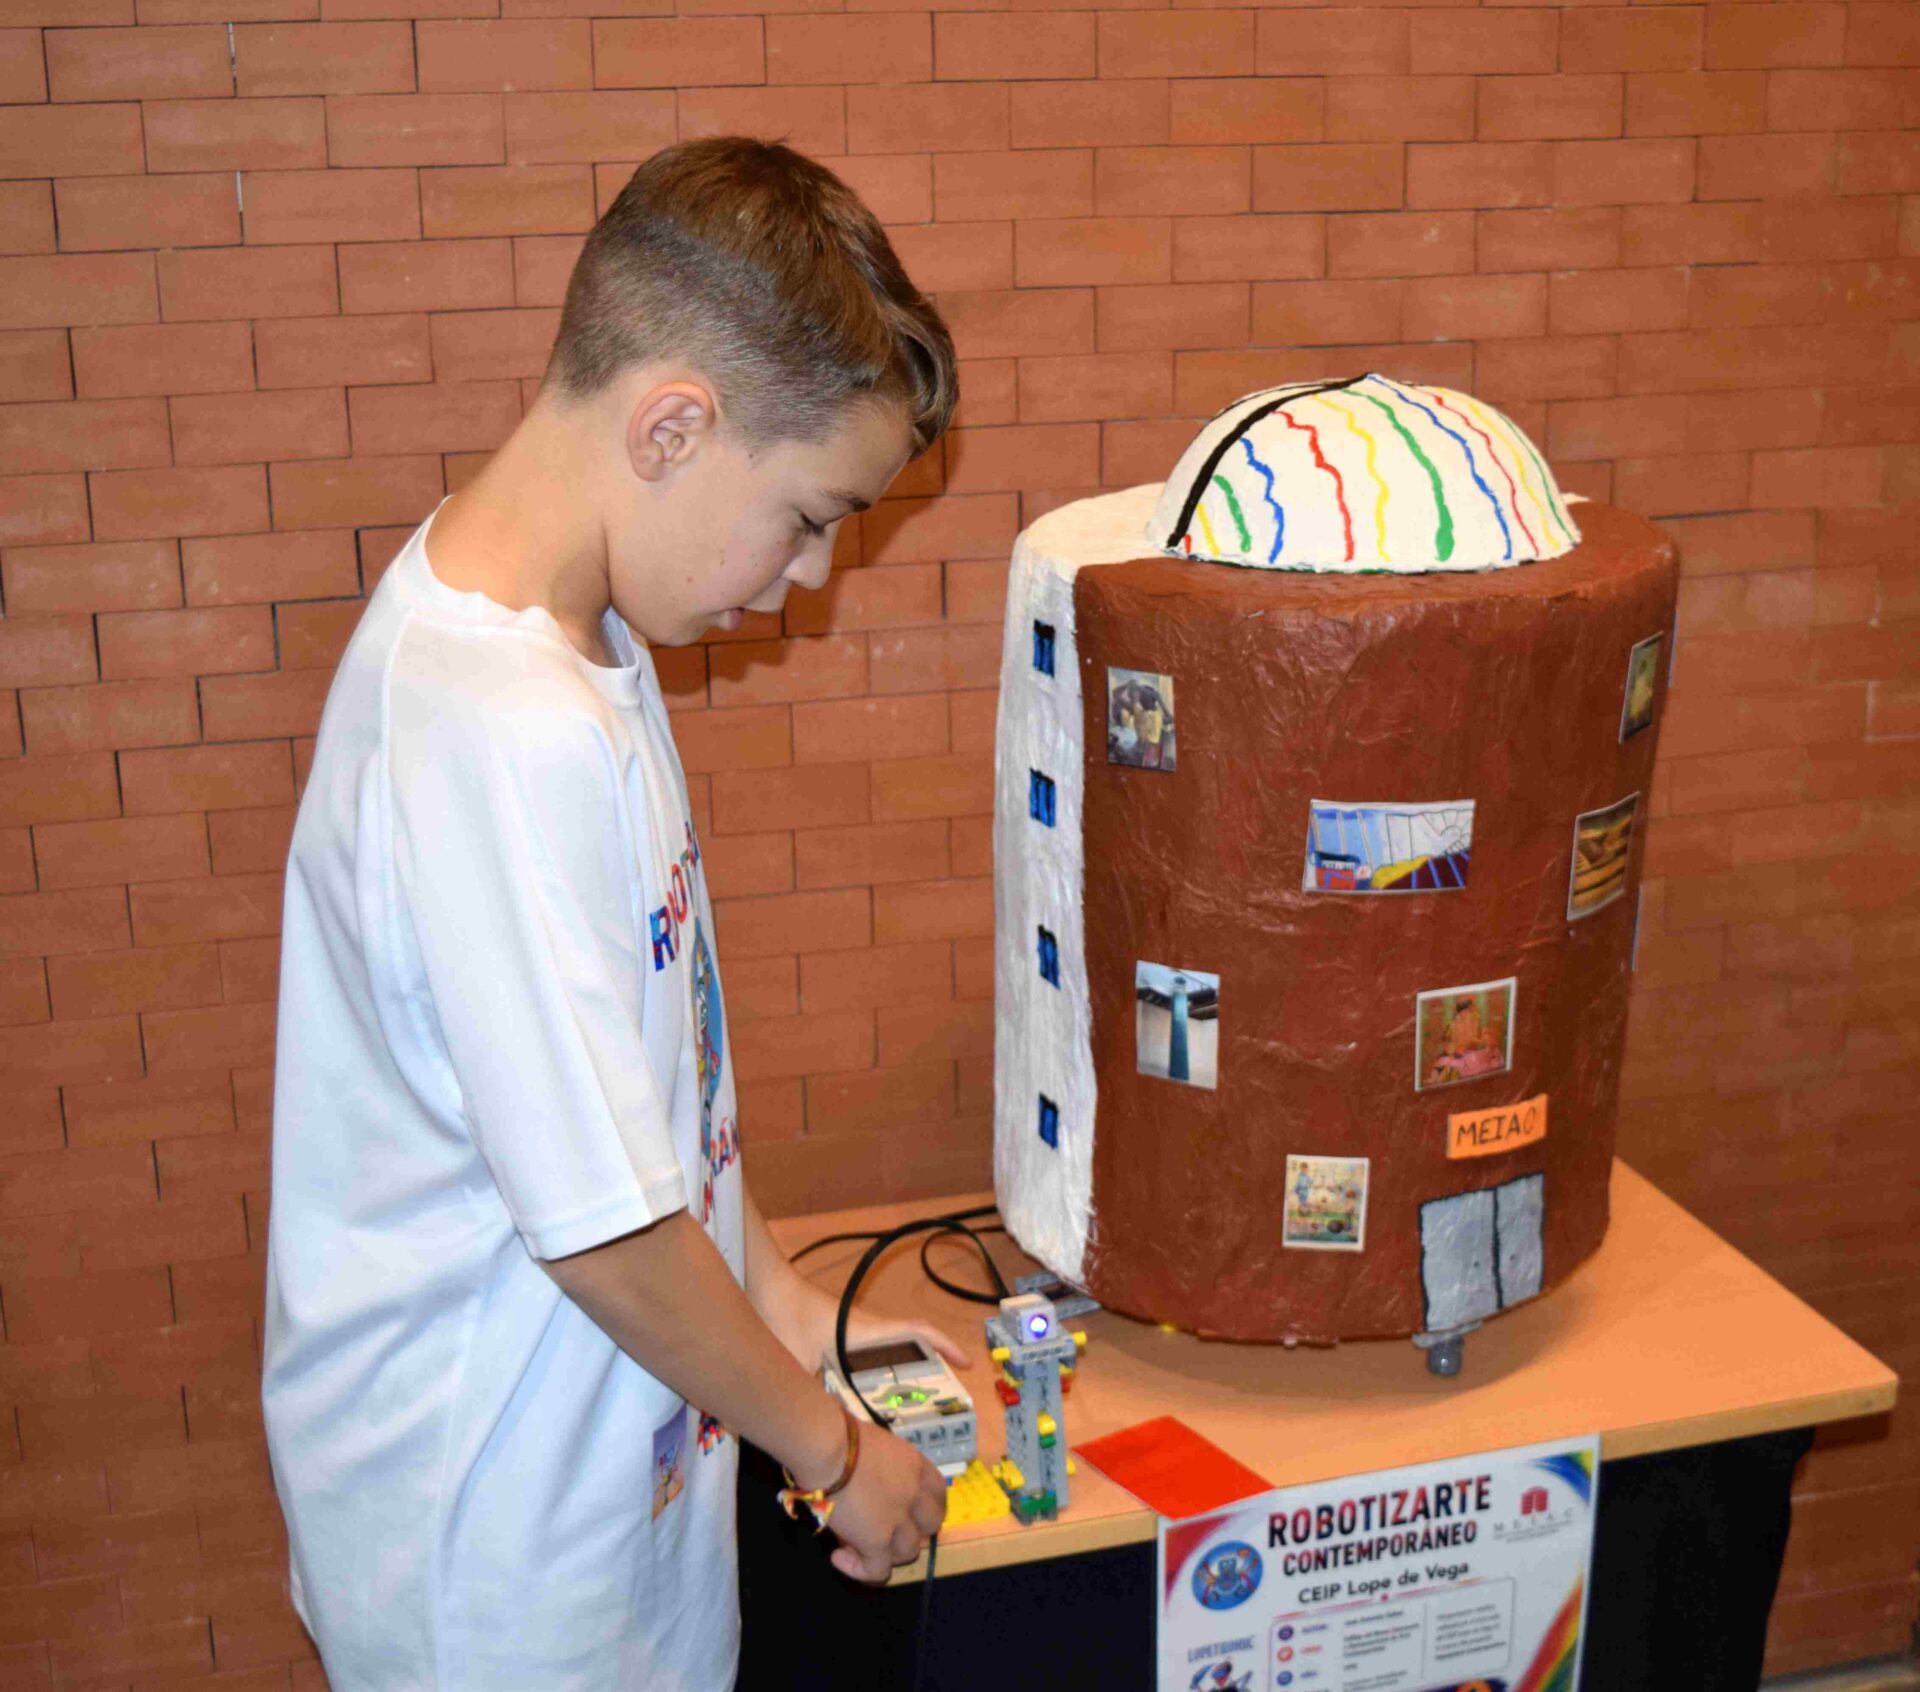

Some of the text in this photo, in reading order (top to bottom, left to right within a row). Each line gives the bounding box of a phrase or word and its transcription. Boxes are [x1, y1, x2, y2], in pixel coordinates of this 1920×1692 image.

[1457, 1107, 1537, 1146] MEIAC
[1268, 1474, 1492, 1548] ROBOTIZARTE
[1282, 1519, 1478, 1577] CONTEMPORÁNEO
[1298, 1562, 1469, 1605] CEIP Lope de Vega
